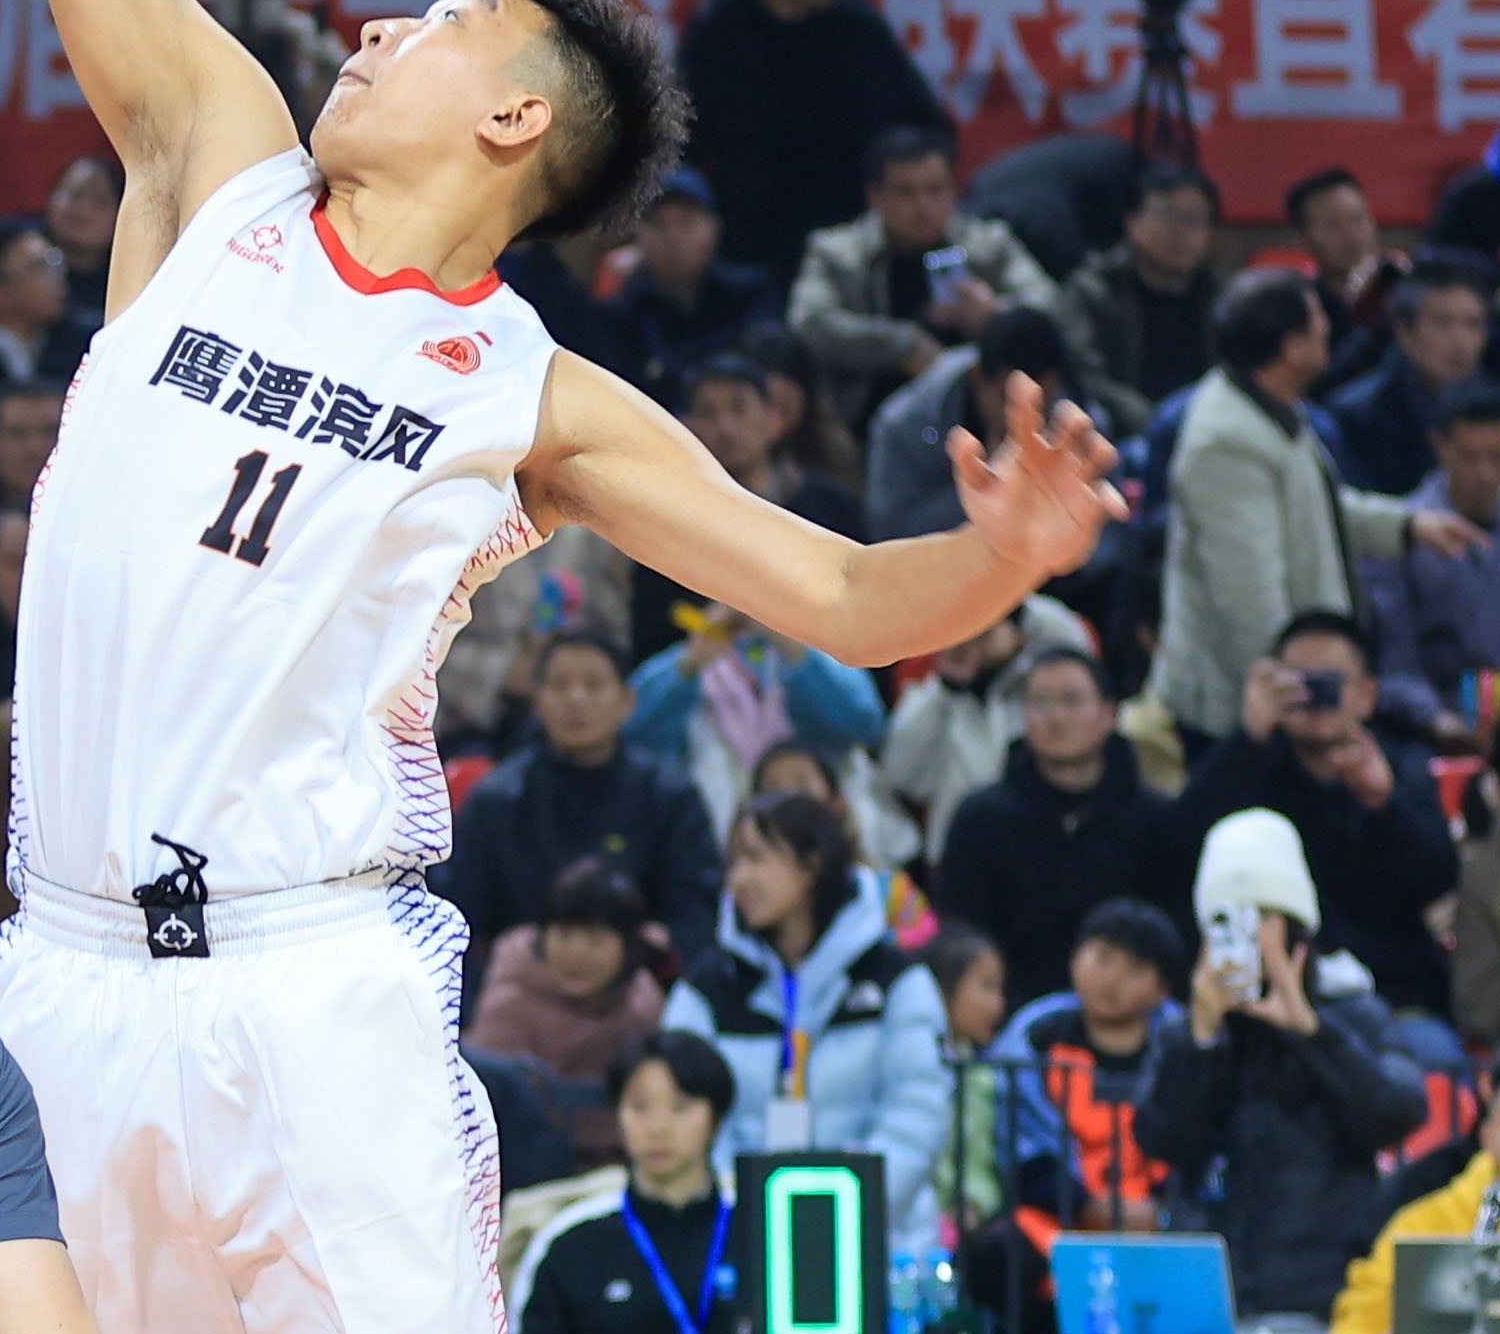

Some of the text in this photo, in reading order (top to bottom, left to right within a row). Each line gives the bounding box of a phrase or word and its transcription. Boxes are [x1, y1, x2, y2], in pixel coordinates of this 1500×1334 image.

[149, 324, 446, 473] 鹰潭滨风
[198, 448, 304, 569] 11
